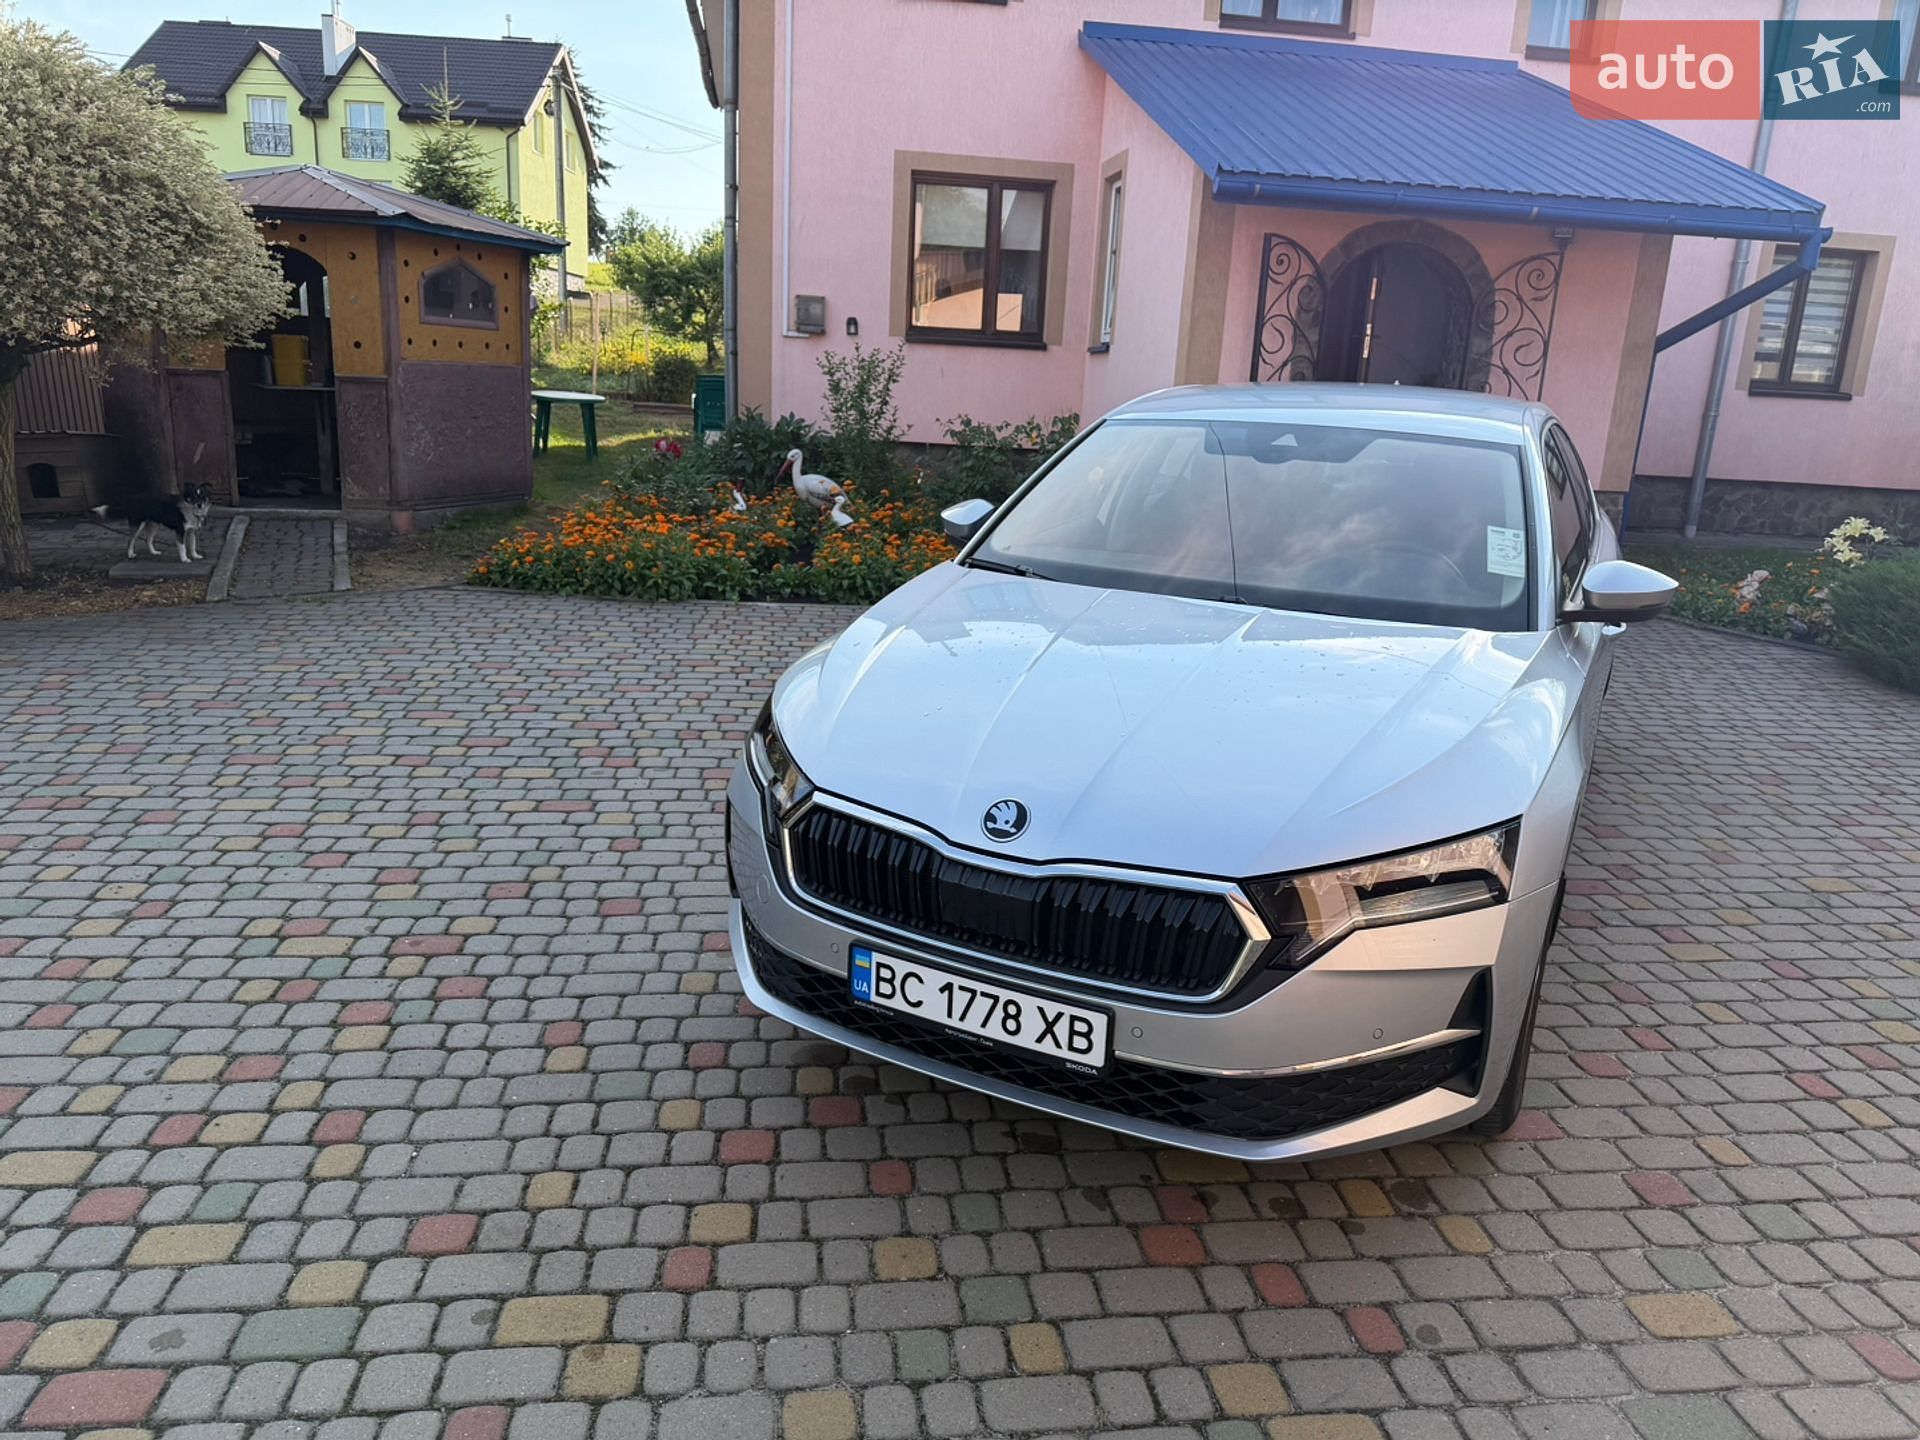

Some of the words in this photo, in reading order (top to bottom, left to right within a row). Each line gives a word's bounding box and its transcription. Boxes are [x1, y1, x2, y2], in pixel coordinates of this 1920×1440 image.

[853, 978, 870, 994] UA
[874, 961, 924, 1009] BC
[938, 981, 1022, 1037] 1778
[1035, 1005, 1094, 1055] XB
